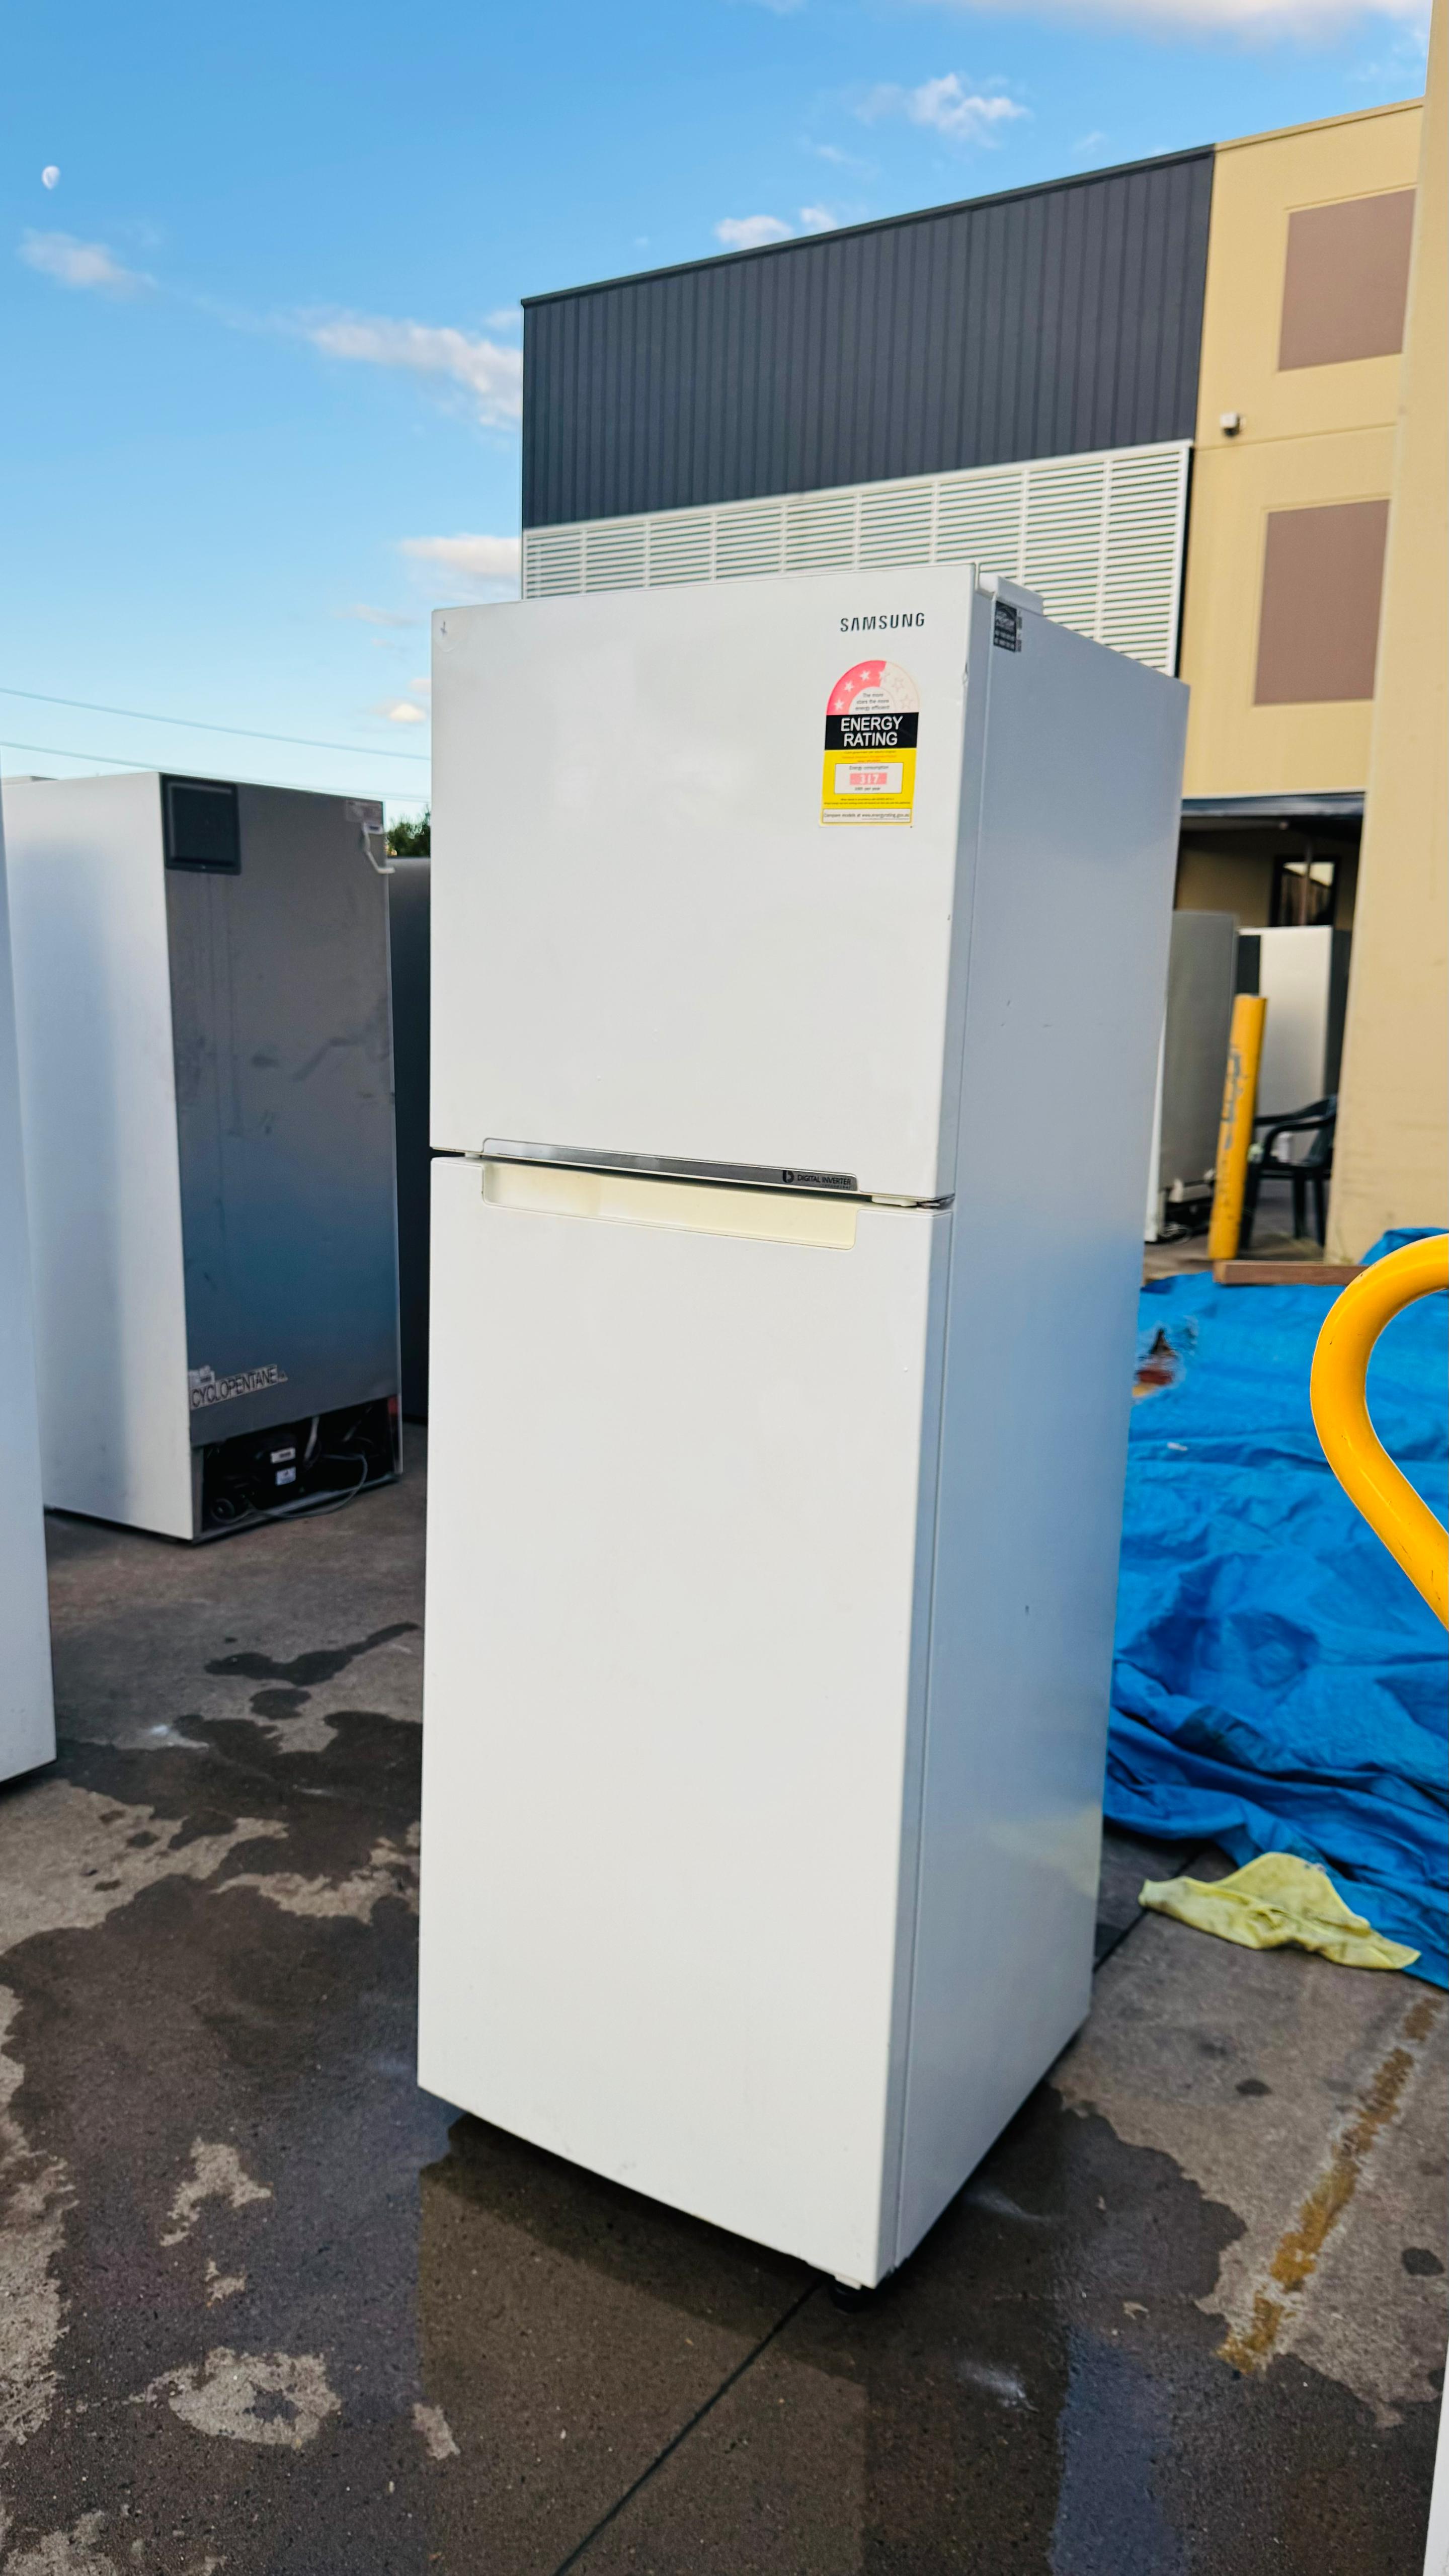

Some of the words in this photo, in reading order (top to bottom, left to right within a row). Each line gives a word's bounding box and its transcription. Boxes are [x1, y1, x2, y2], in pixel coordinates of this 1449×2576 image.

[840, 612, 925, 632] SAMSUNG
[841, 715, 903, 732] ENERGY
[844, 732, 898, 747] RATING
[797, 1174, 821, 1183] DIGITAL
[822, 1177, 851, 1185] INVERTER
[192, 1366, 277, 1407] CYCLOPENTANE
